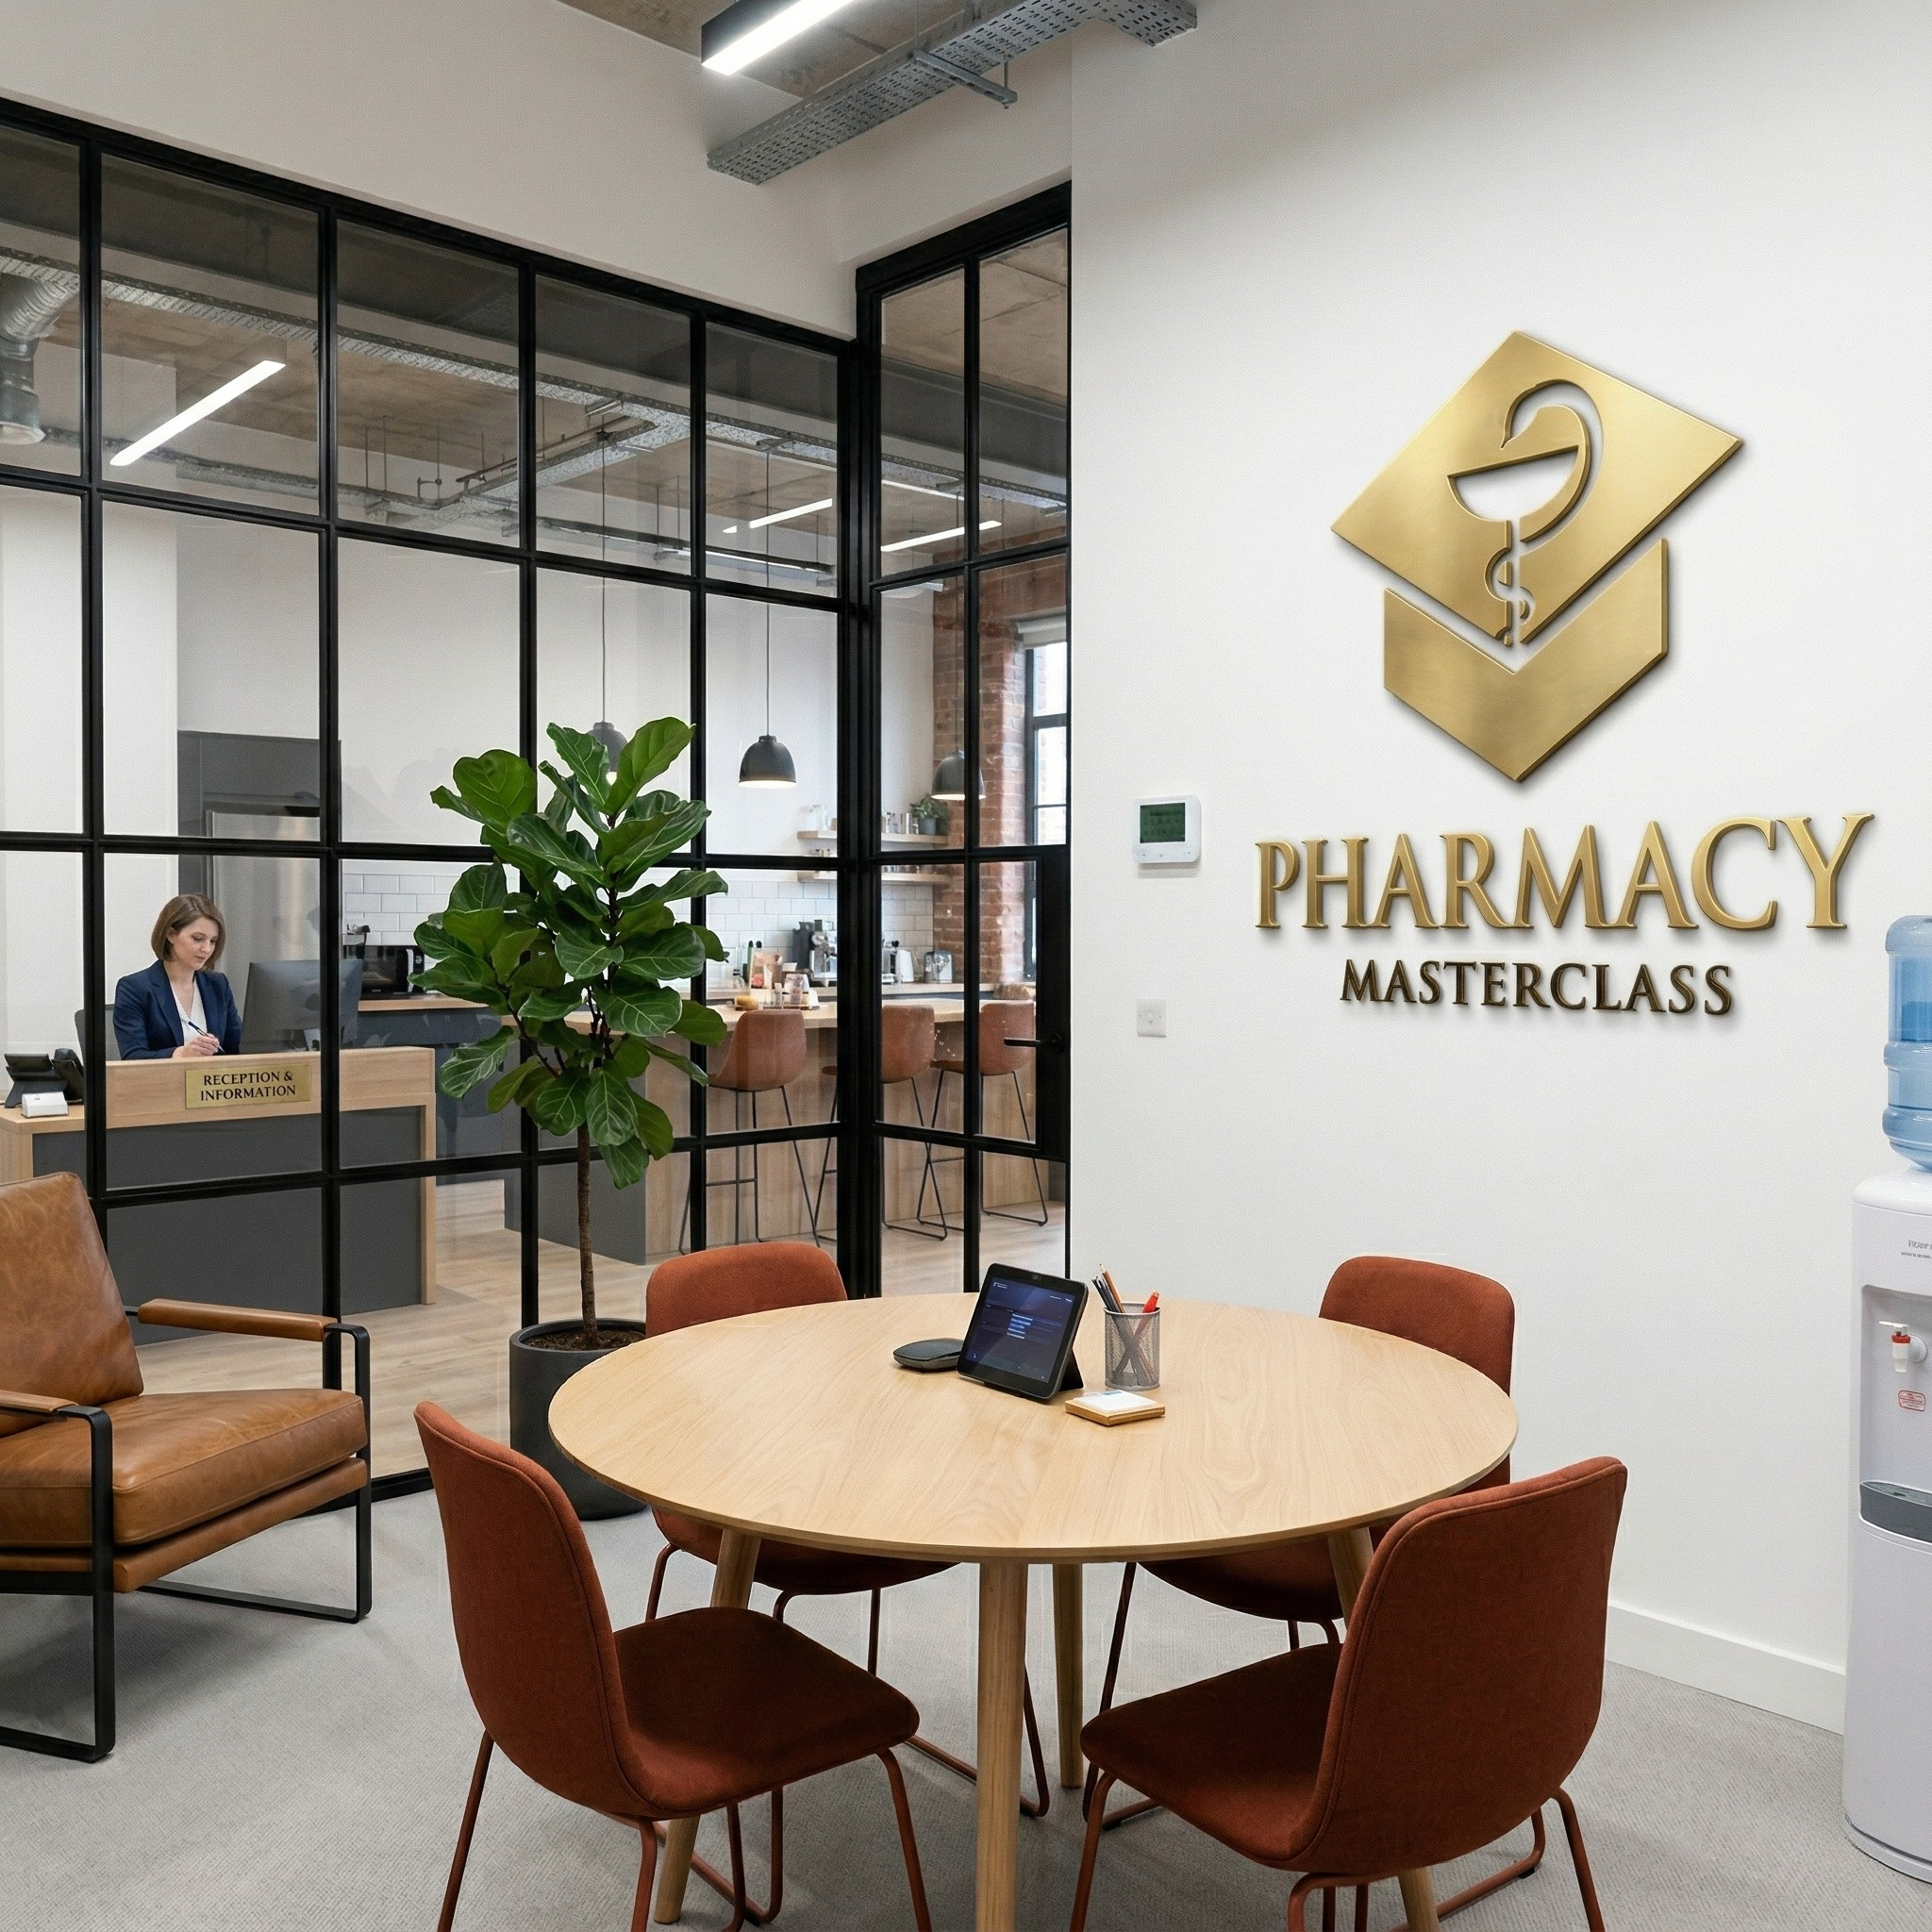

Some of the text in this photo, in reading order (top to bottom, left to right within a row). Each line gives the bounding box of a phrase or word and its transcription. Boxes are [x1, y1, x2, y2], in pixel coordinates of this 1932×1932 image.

[1255, 813, 1875, 930] PHARMACY
[1340, 958, 1733, 1016] MASTERCLASS
[200, 1085, 296, 1101] INFORMATION
[204, 1071, 293, 1086] RECEPTION &
